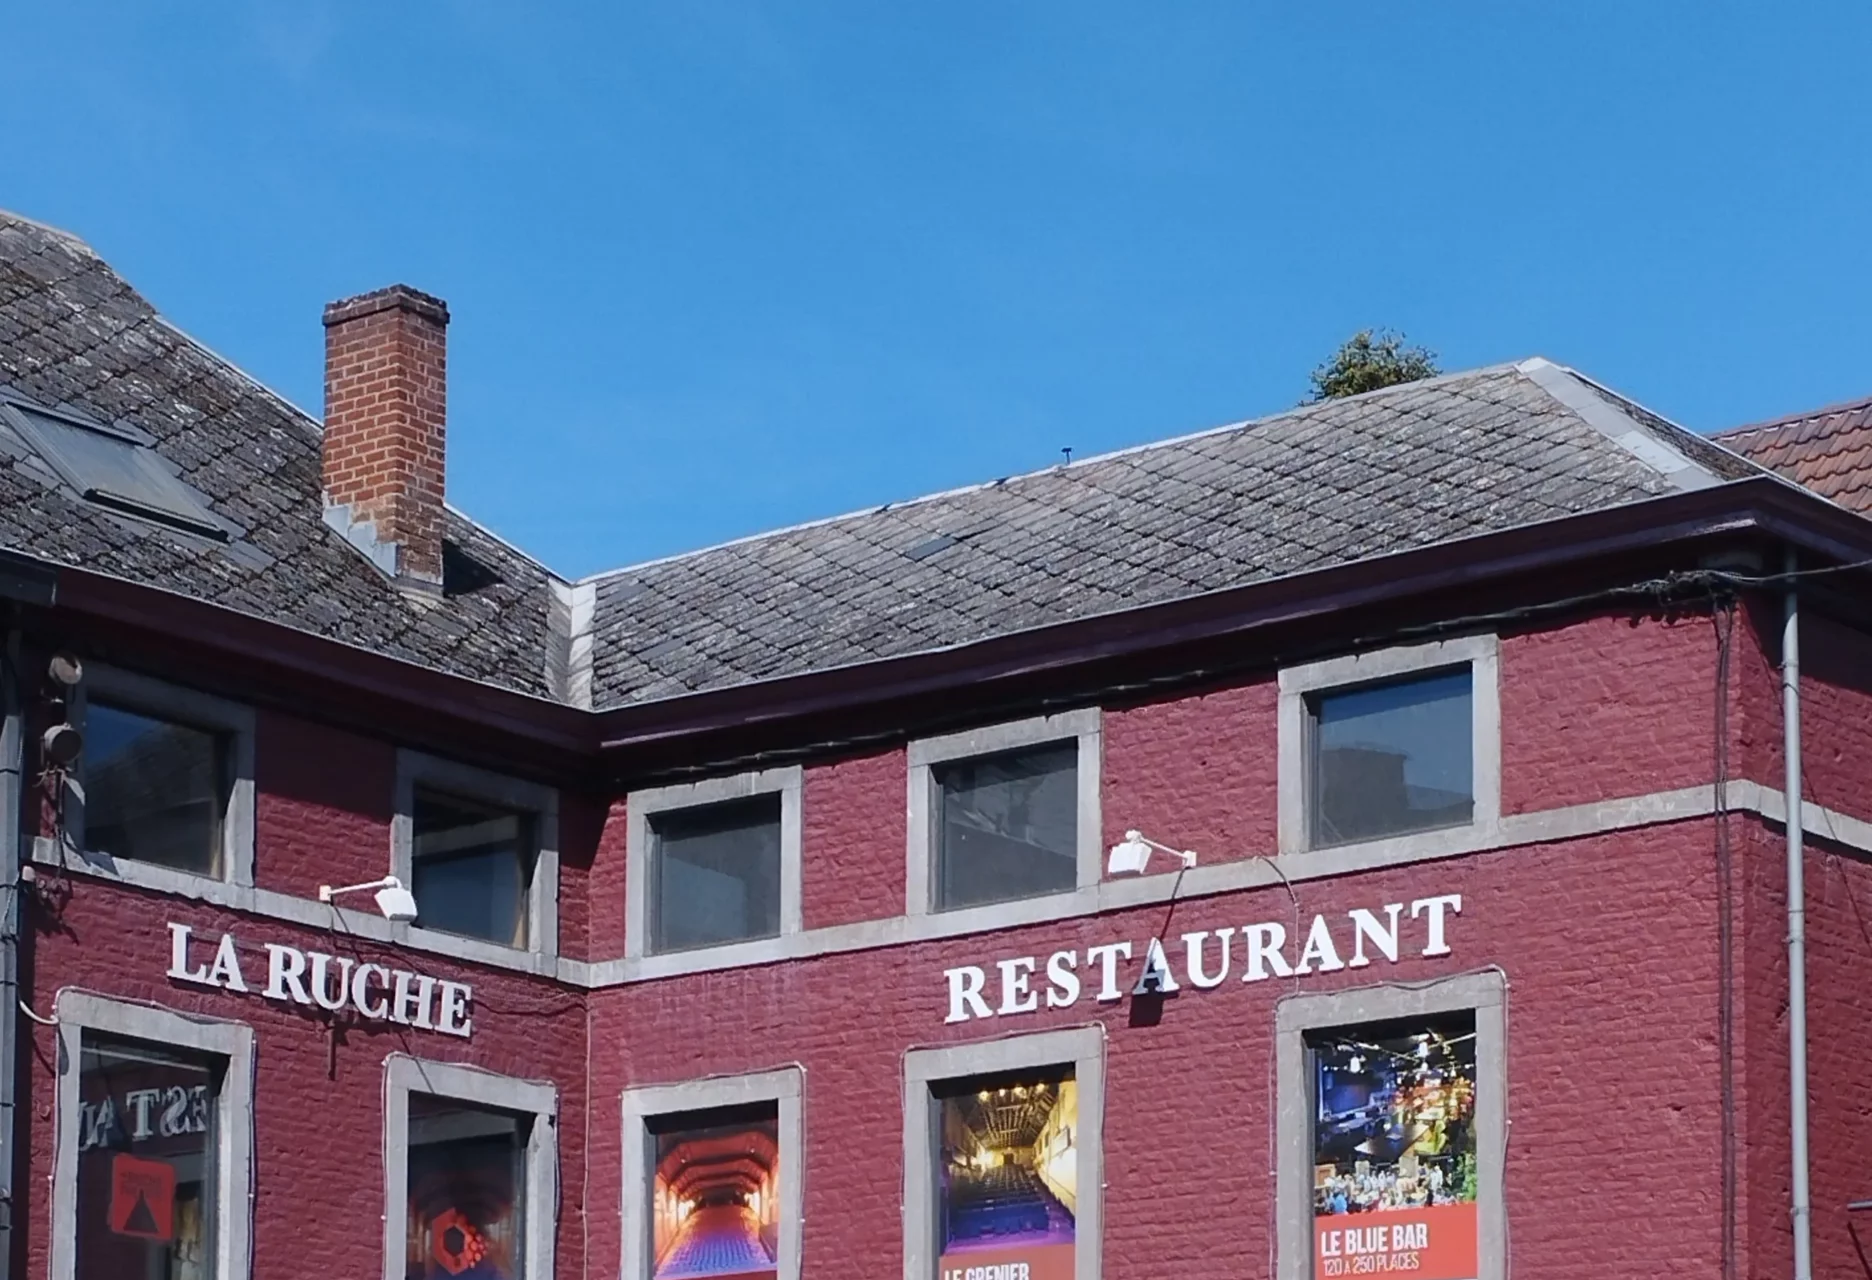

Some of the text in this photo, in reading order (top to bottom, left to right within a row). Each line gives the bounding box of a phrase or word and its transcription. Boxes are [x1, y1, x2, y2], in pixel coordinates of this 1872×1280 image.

[166, 922, 472, 1038] LA RUCHE
[943, 894, 1462, 1024] RESTAURANT
[1321, 1223, 1429, 1257] LE BLUE BAR
[1376, 1251, 1420, 1272] PLACES
